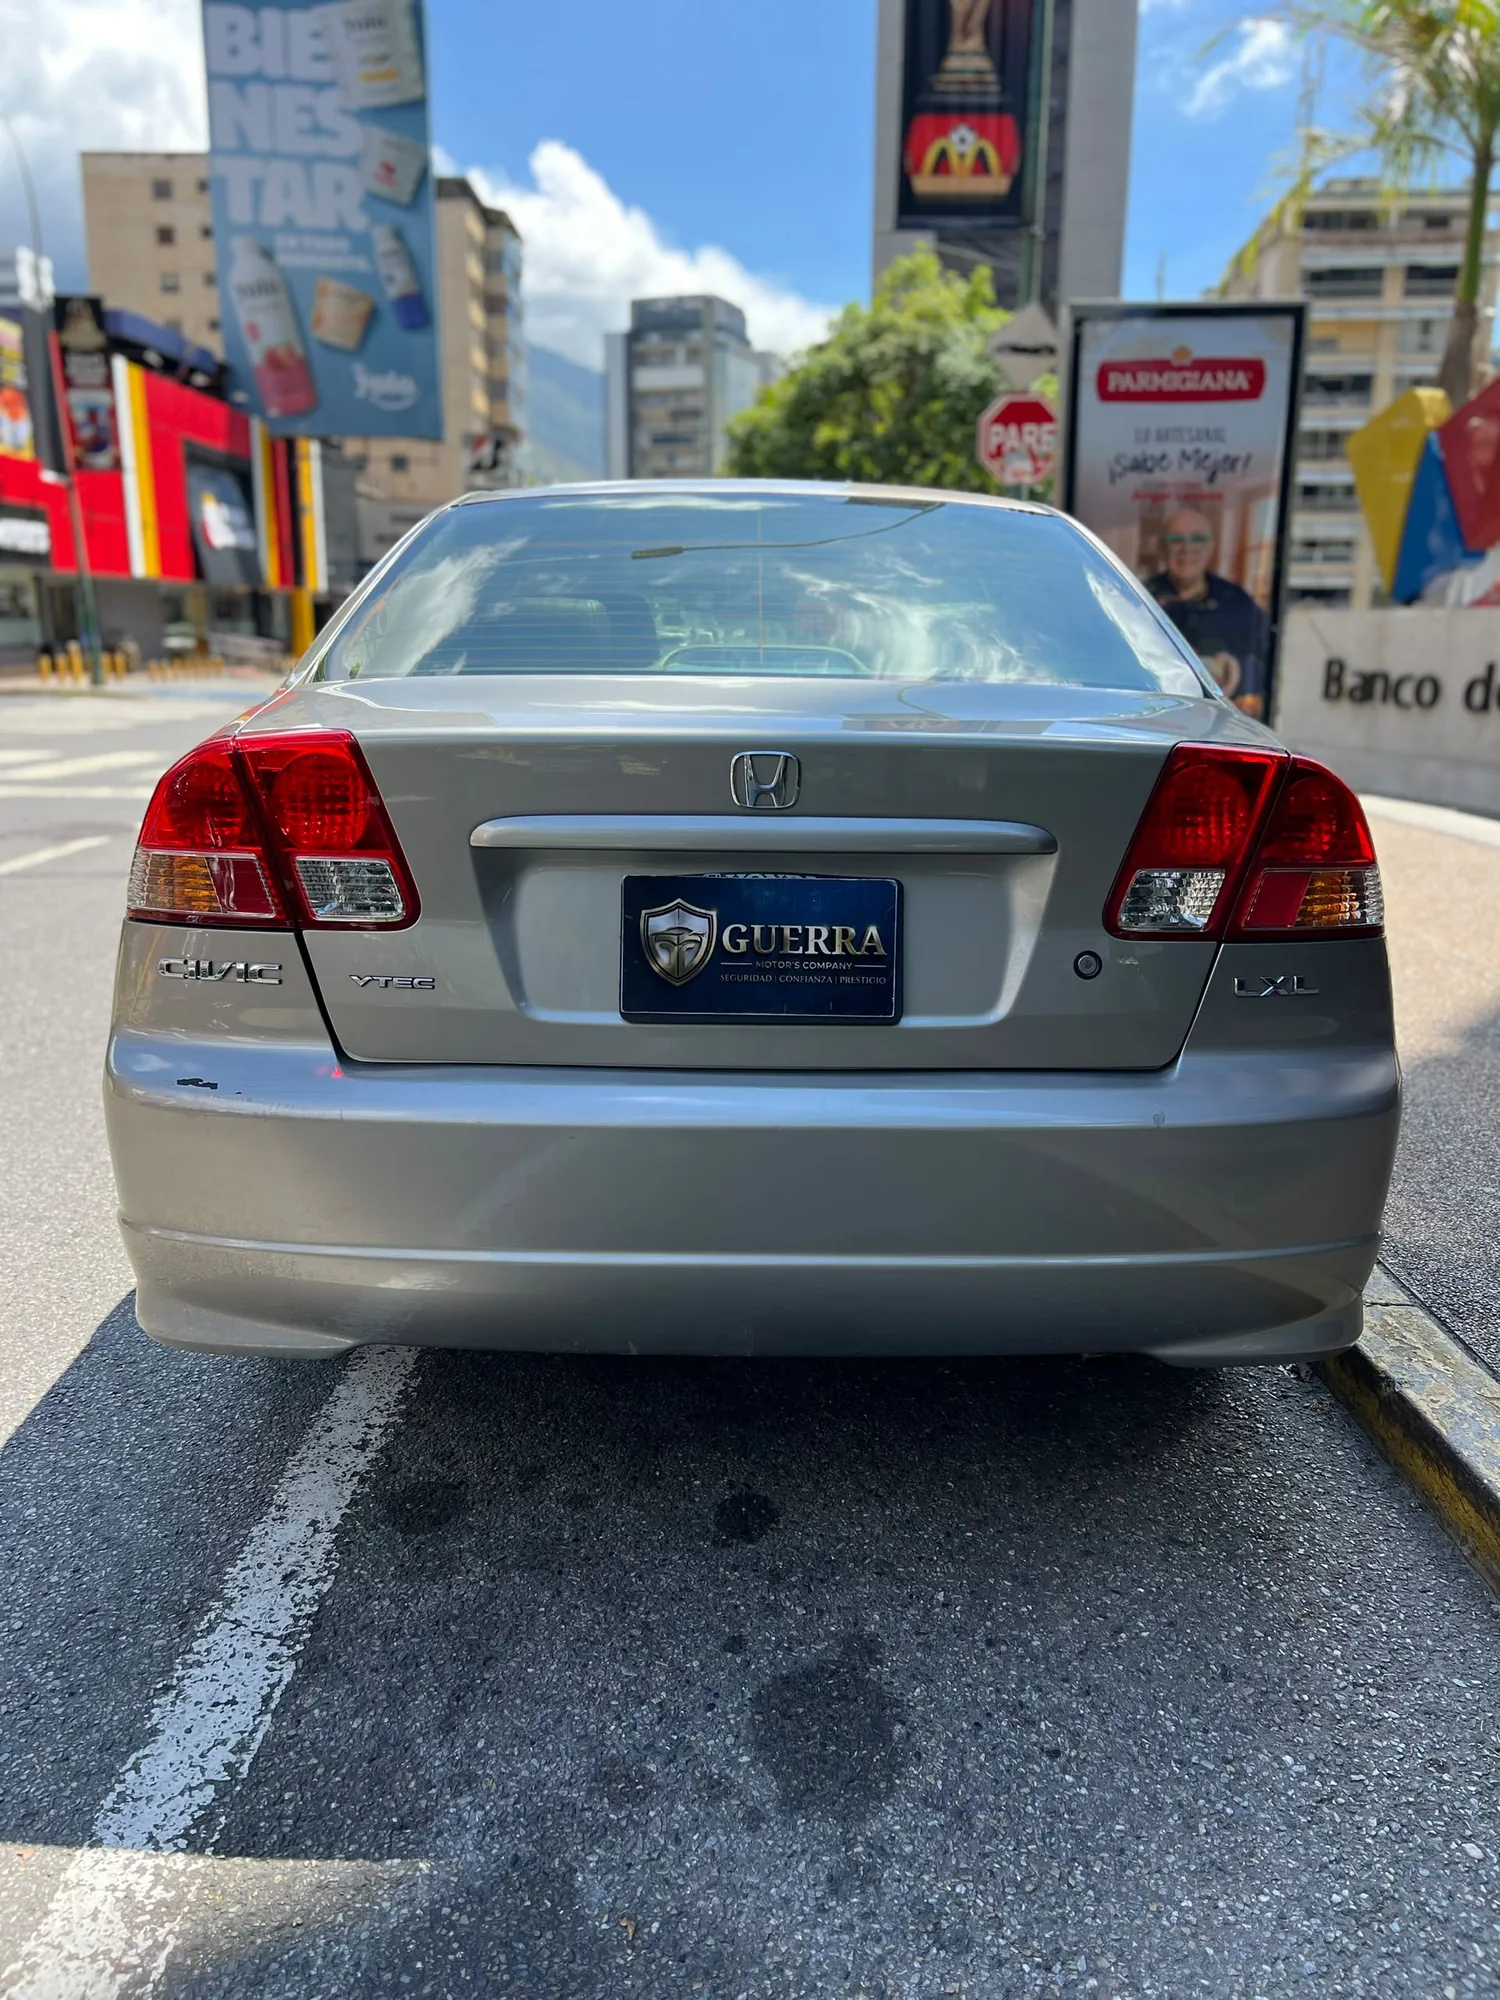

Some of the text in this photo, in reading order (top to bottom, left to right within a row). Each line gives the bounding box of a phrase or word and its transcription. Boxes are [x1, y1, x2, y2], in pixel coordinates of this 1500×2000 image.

[209, 80, 365, 157] NES
[211, 157, 371, 234] TAR
[1107, 370, 1250, 393] PARMIGIANA
[989, 421, 1058, 455] PARE
[1322, 657, 1500, 714] Banco d
[722, 924, 887, 956] GUERRA
[158, 957, 283, 985] CIVIC
[720, 973, 887, 985] SEGURIDAD CONFIANZA PRESTIGIO
[755, 960, 853, 971] MOTOR'S COMPANY
[349, 974, 436, 990] VTEC
[1233, 975, 1320, 997] LXL
